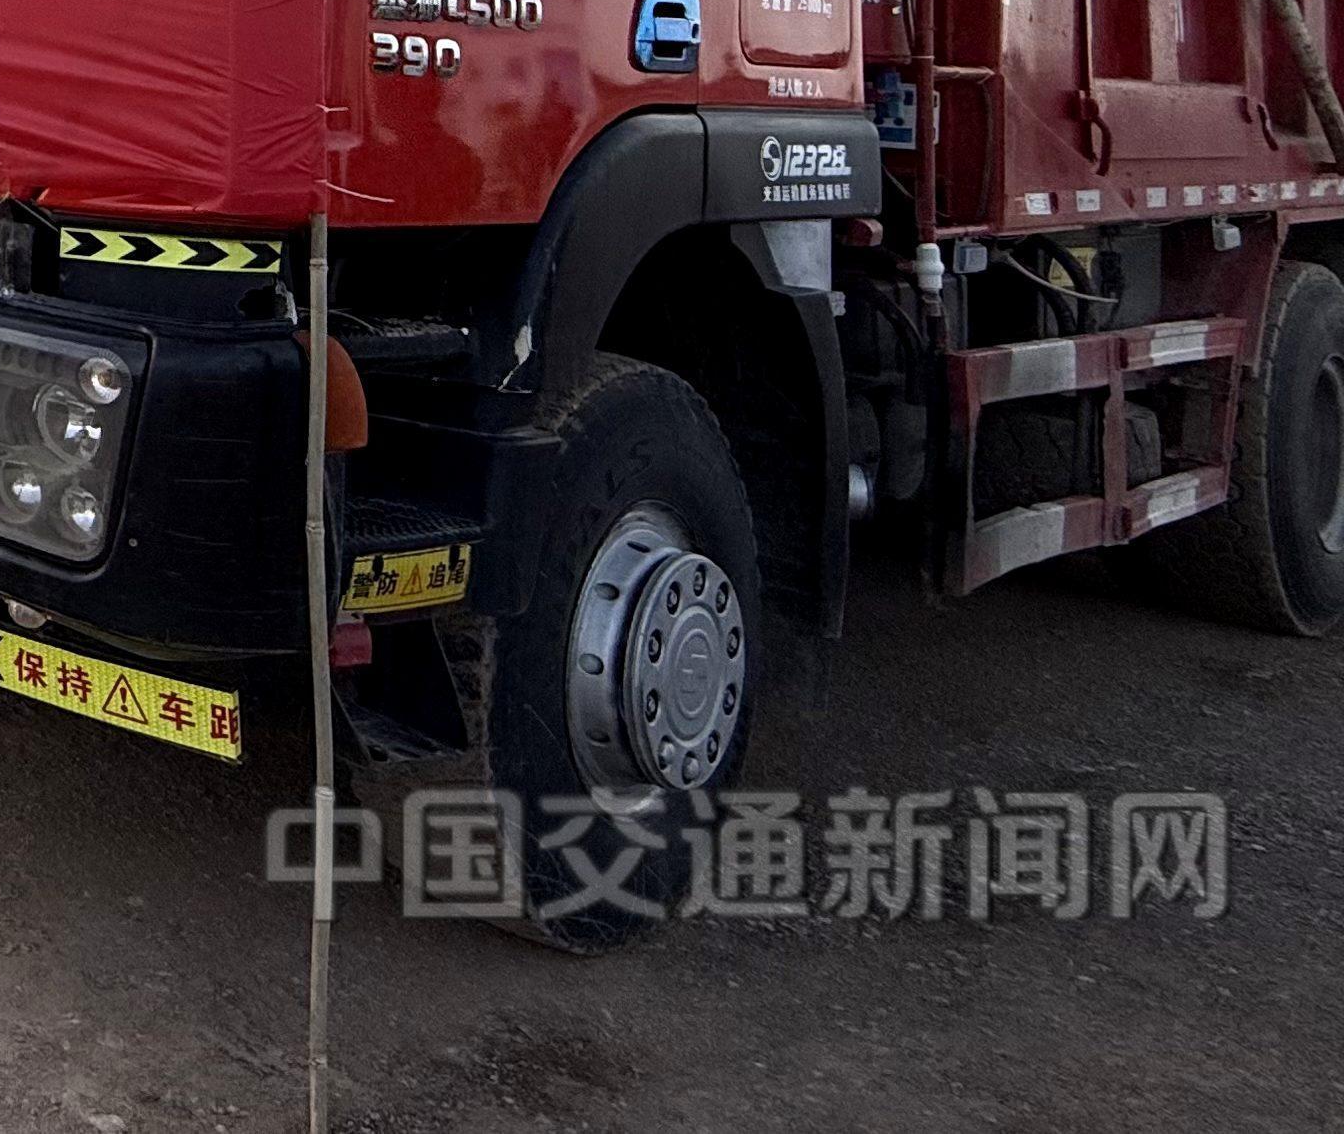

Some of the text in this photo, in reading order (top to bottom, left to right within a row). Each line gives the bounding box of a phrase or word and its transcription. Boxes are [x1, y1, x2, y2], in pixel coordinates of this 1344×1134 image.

[371, 31, 462, 78] 390
[783, 144, 852, 177] 12328
[14, 647, 92, 704] 保持
